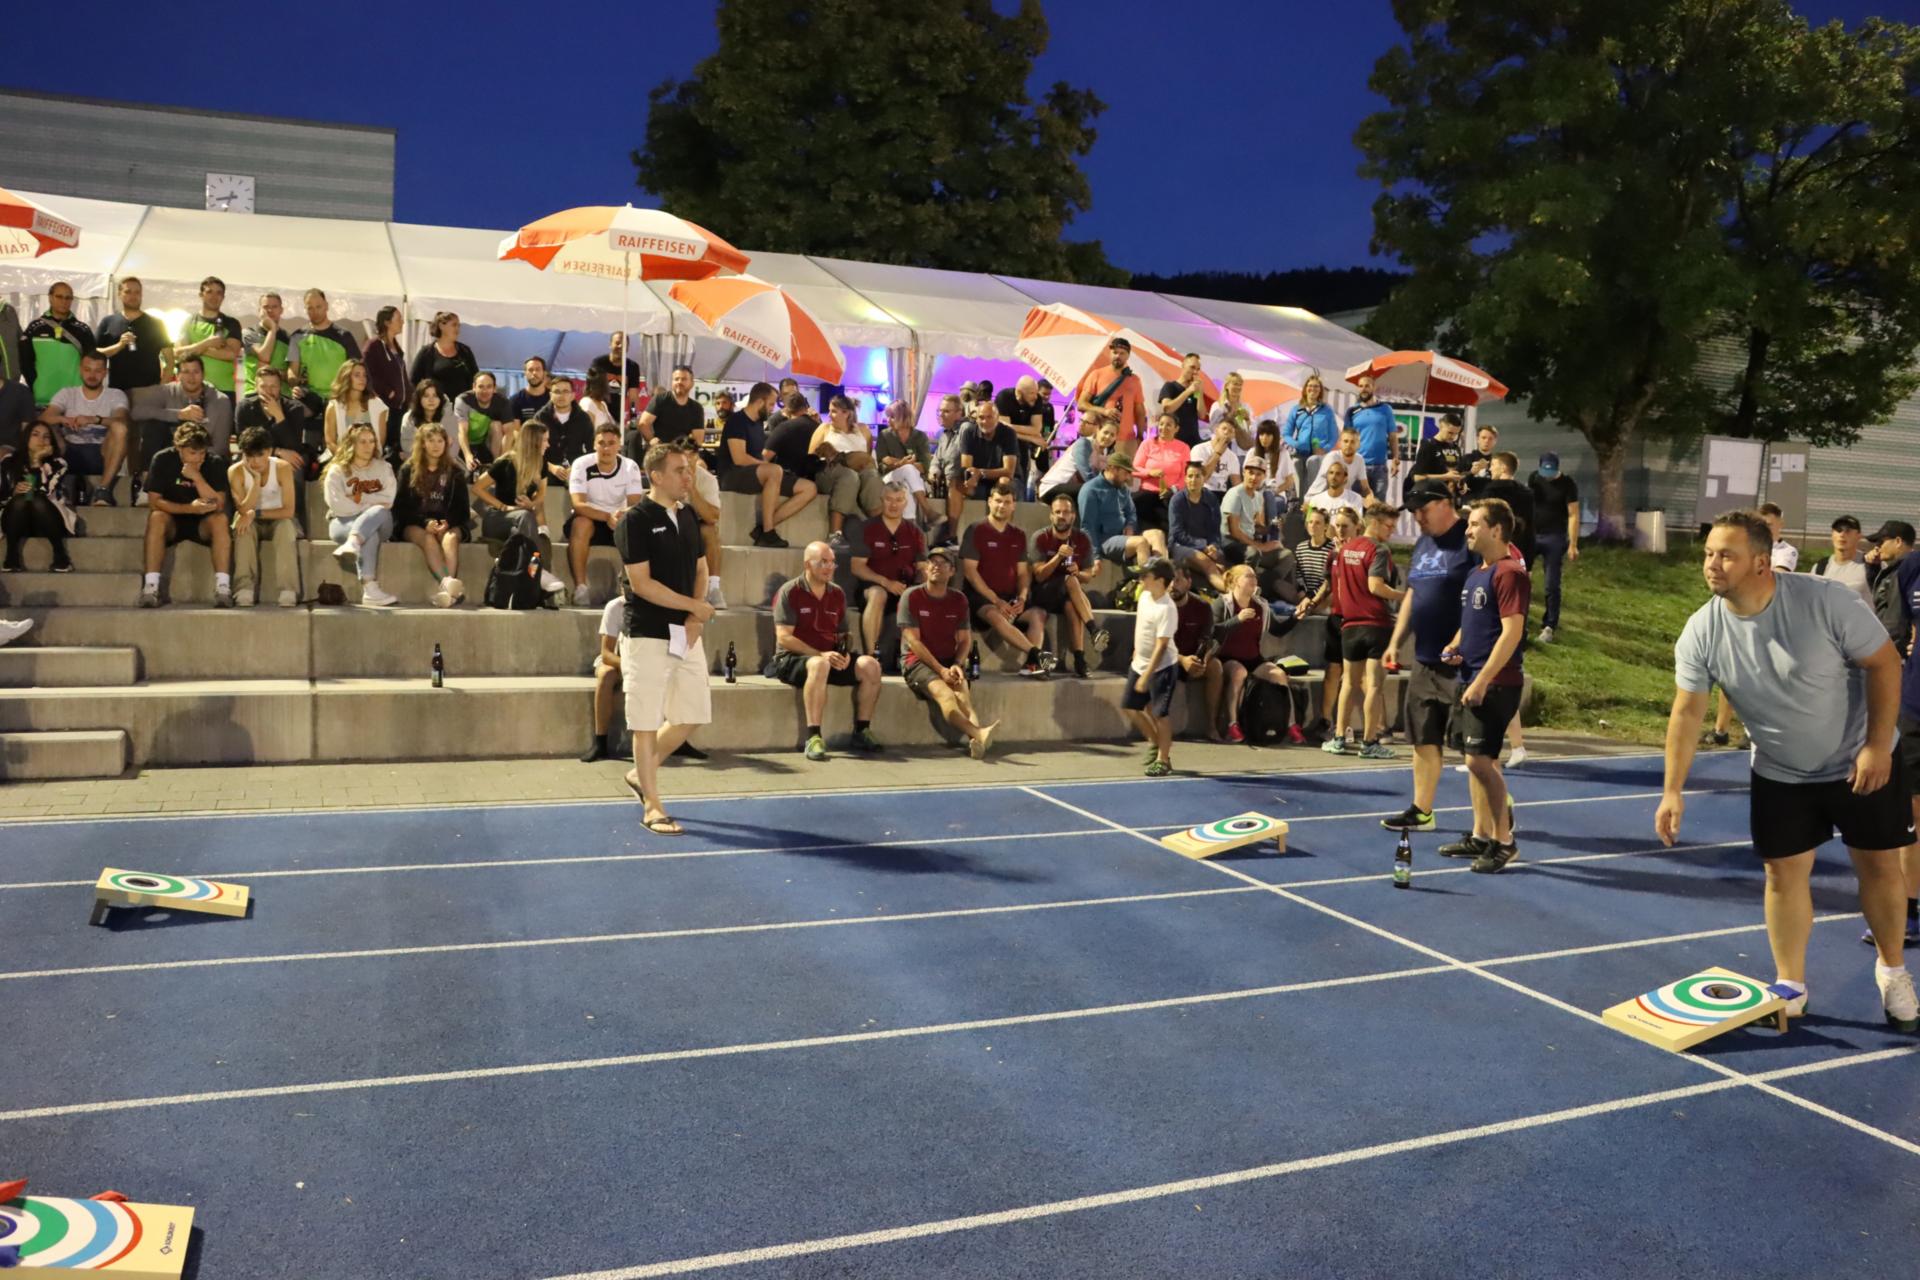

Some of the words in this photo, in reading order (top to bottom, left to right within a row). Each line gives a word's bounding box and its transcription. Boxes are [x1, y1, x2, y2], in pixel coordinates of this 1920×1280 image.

[617, 234, 698, 256] RAIFFEISEN
[722, 326, 781, 362] RAIFFEISEN
[1020, 347, 1068, 389] RAIFFEISEN
[1435, 367, 1483, 387] RAIFFEISEN
